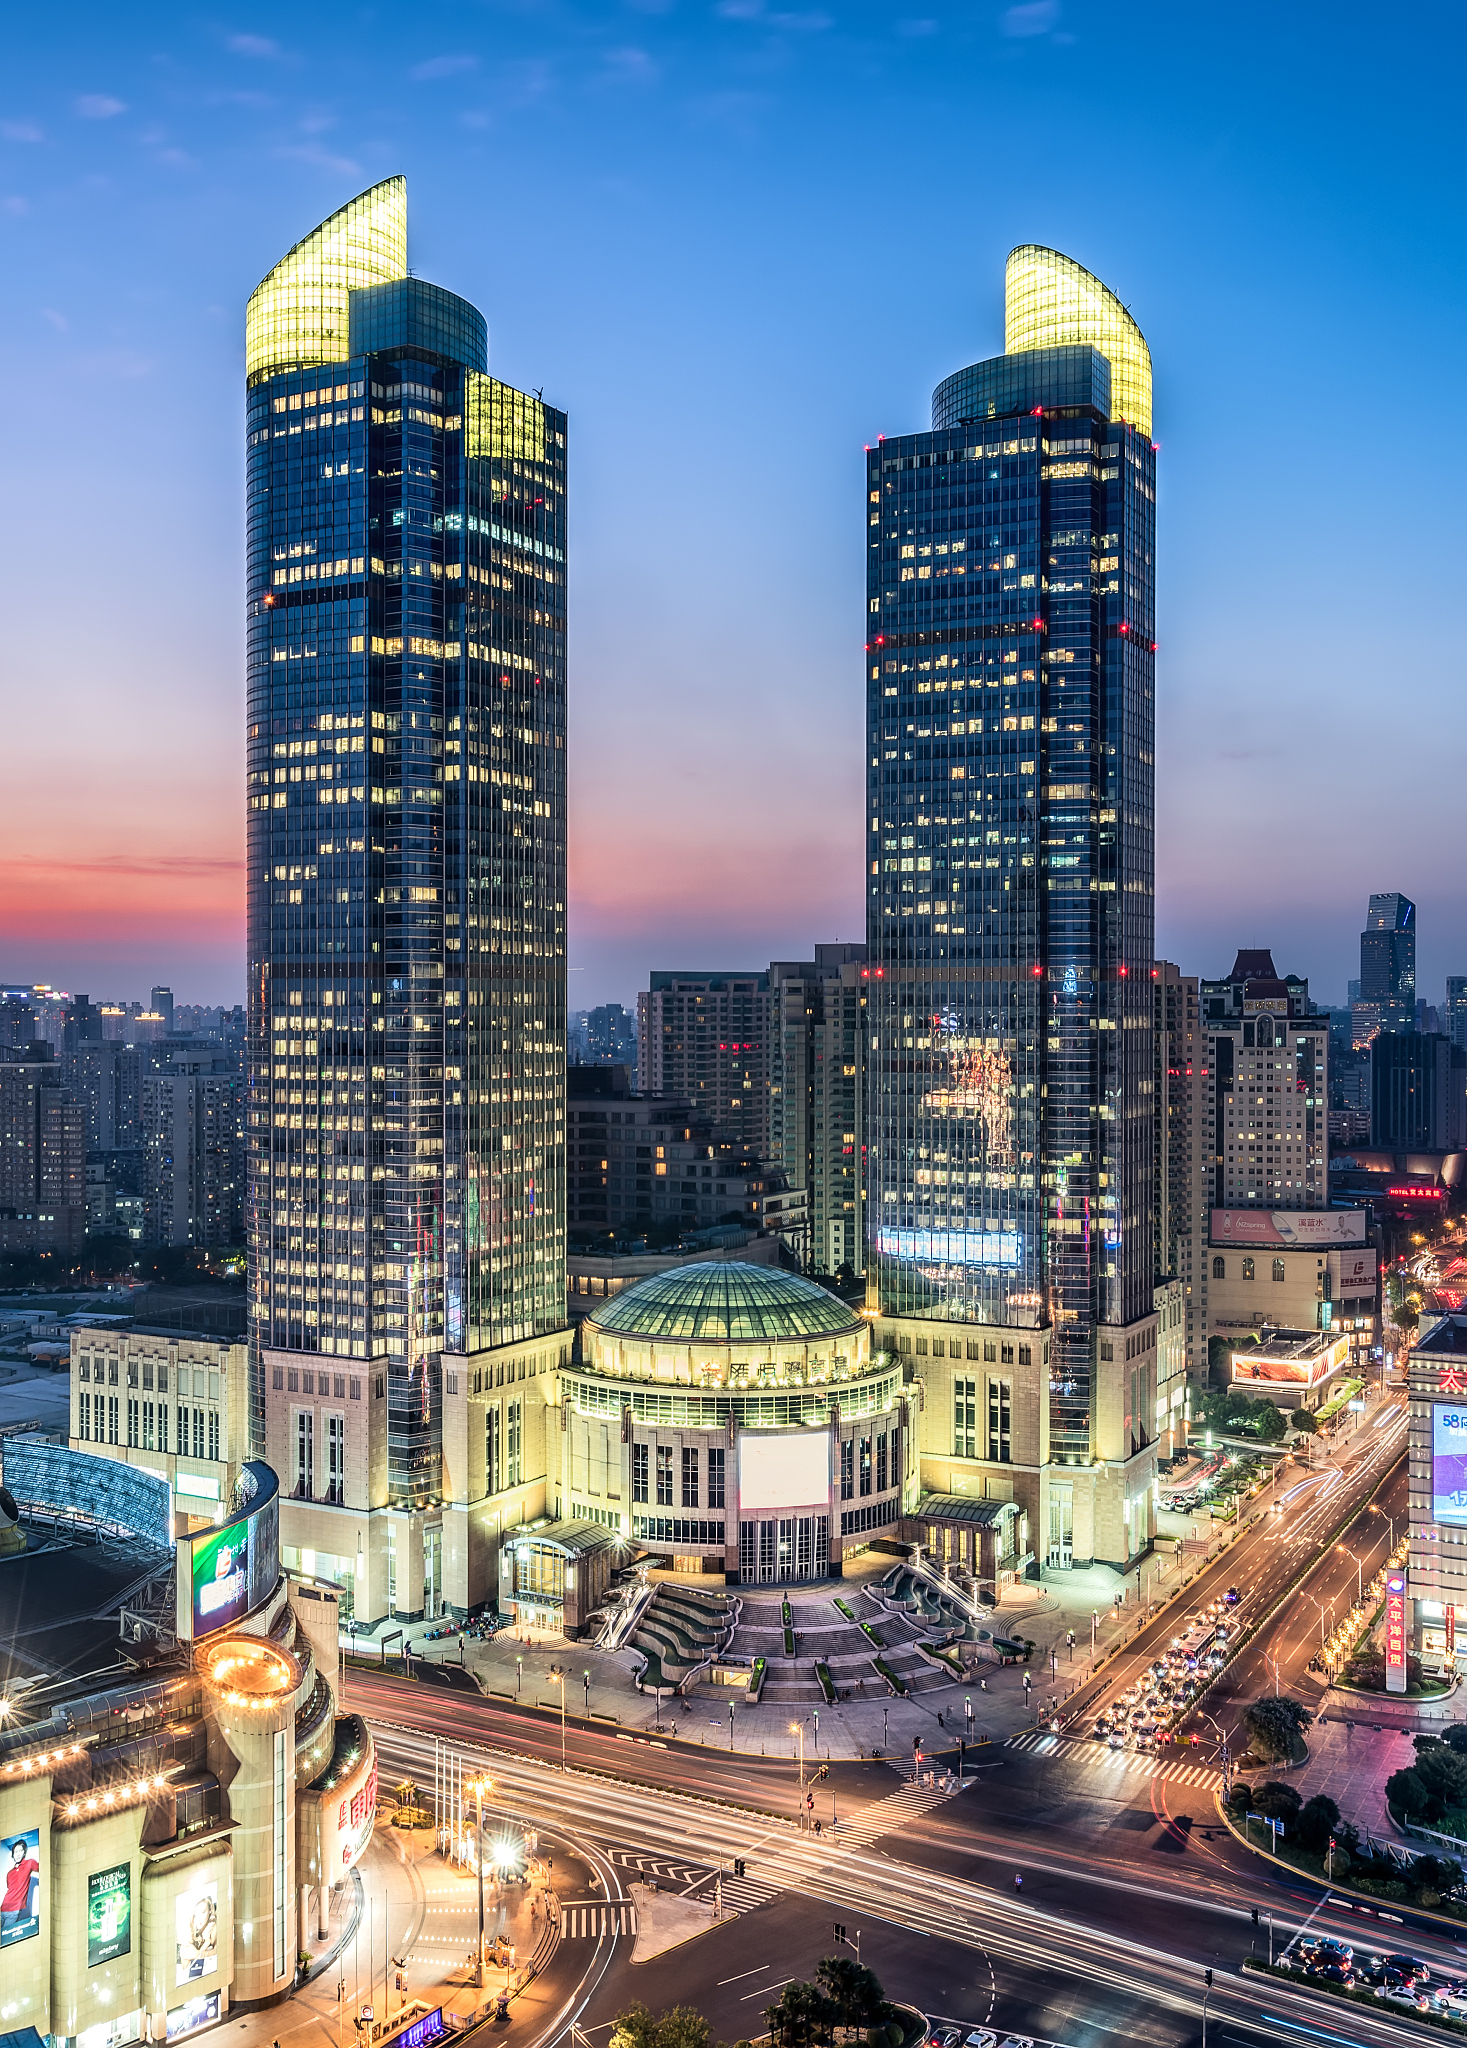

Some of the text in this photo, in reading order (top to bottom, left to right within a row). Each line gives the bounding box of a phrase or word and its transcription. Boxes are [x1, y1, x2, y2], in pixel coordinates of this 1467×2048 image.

[1389, 1596, 1402, 1665] 太平洋百货
